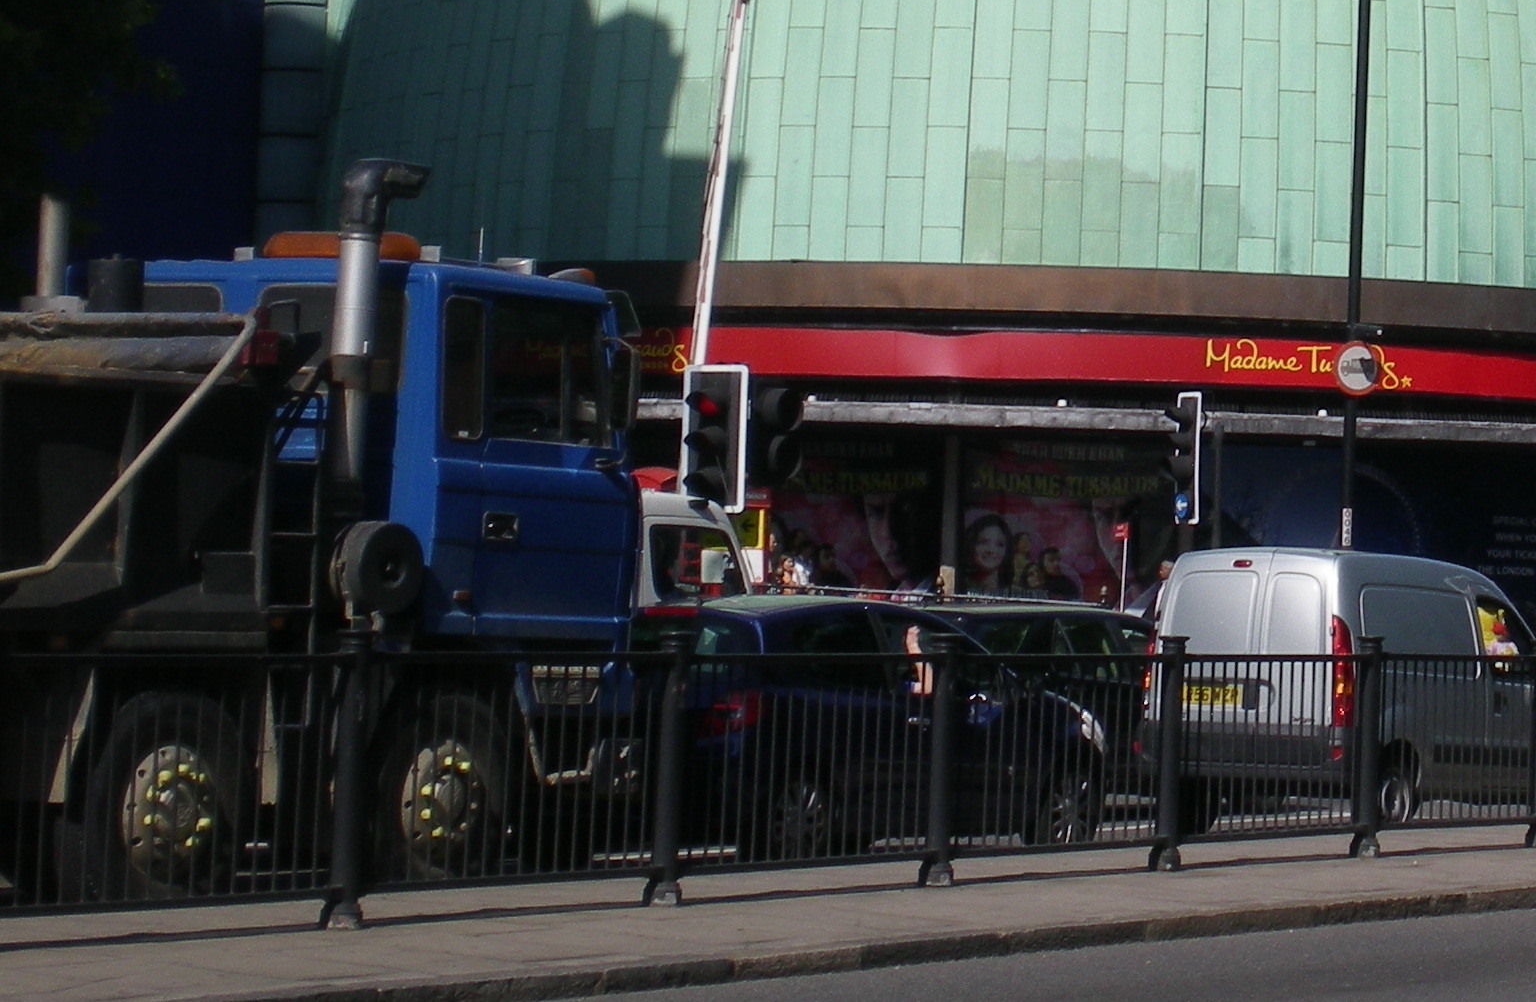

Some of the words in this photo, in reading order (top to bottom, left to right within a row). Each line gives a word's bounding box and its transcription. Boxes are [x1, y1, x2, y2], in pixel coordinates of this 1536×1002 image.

[1205, 337, 1303, 373] Madame
[1495, 532, 1522, 542] WHEN
[1486, 549, 1512, 558] YOUR
[1496, 566, 1534, 576] LONDON
